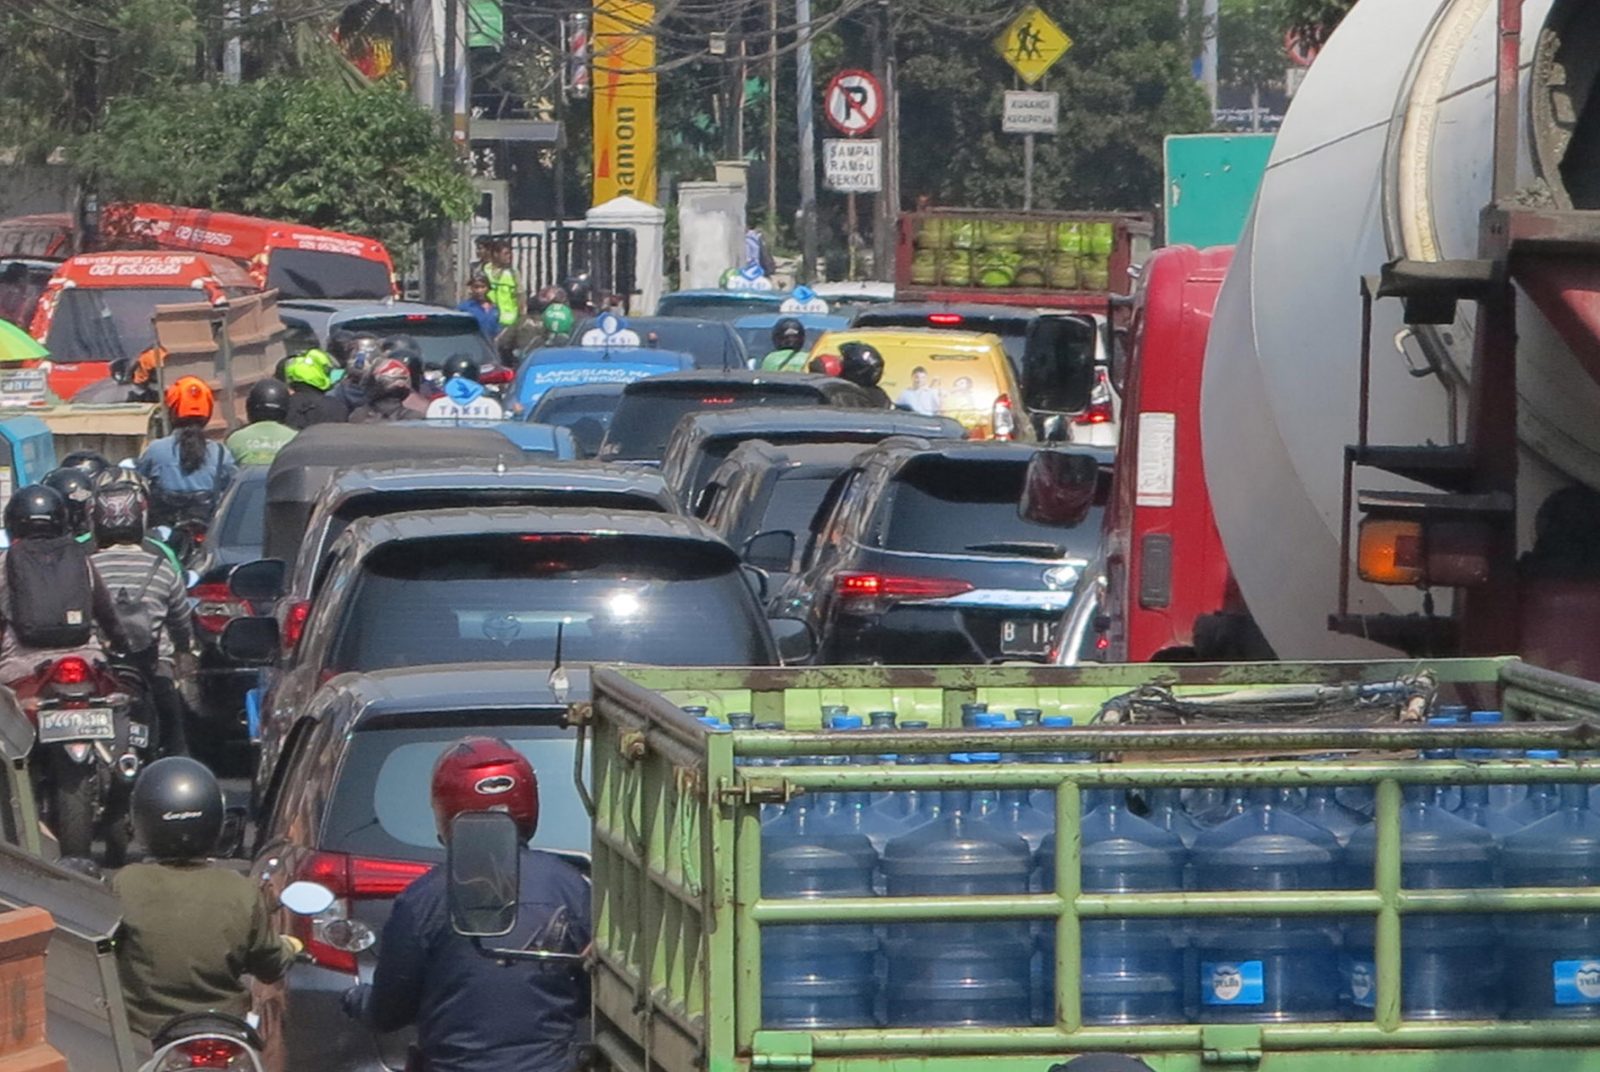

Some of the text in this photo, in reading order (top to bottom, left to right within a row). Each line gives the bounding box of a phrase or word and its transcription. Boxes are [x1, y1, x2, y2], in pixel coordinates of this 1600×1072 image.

[842, 86, 867, 121] P
[830, 145, 874, 158] SAMPAI
[830, 160, 874, 171] RAMBU
[439, 406, 489, 415] TAKSI
[1004, 621, 1015, 642] B
